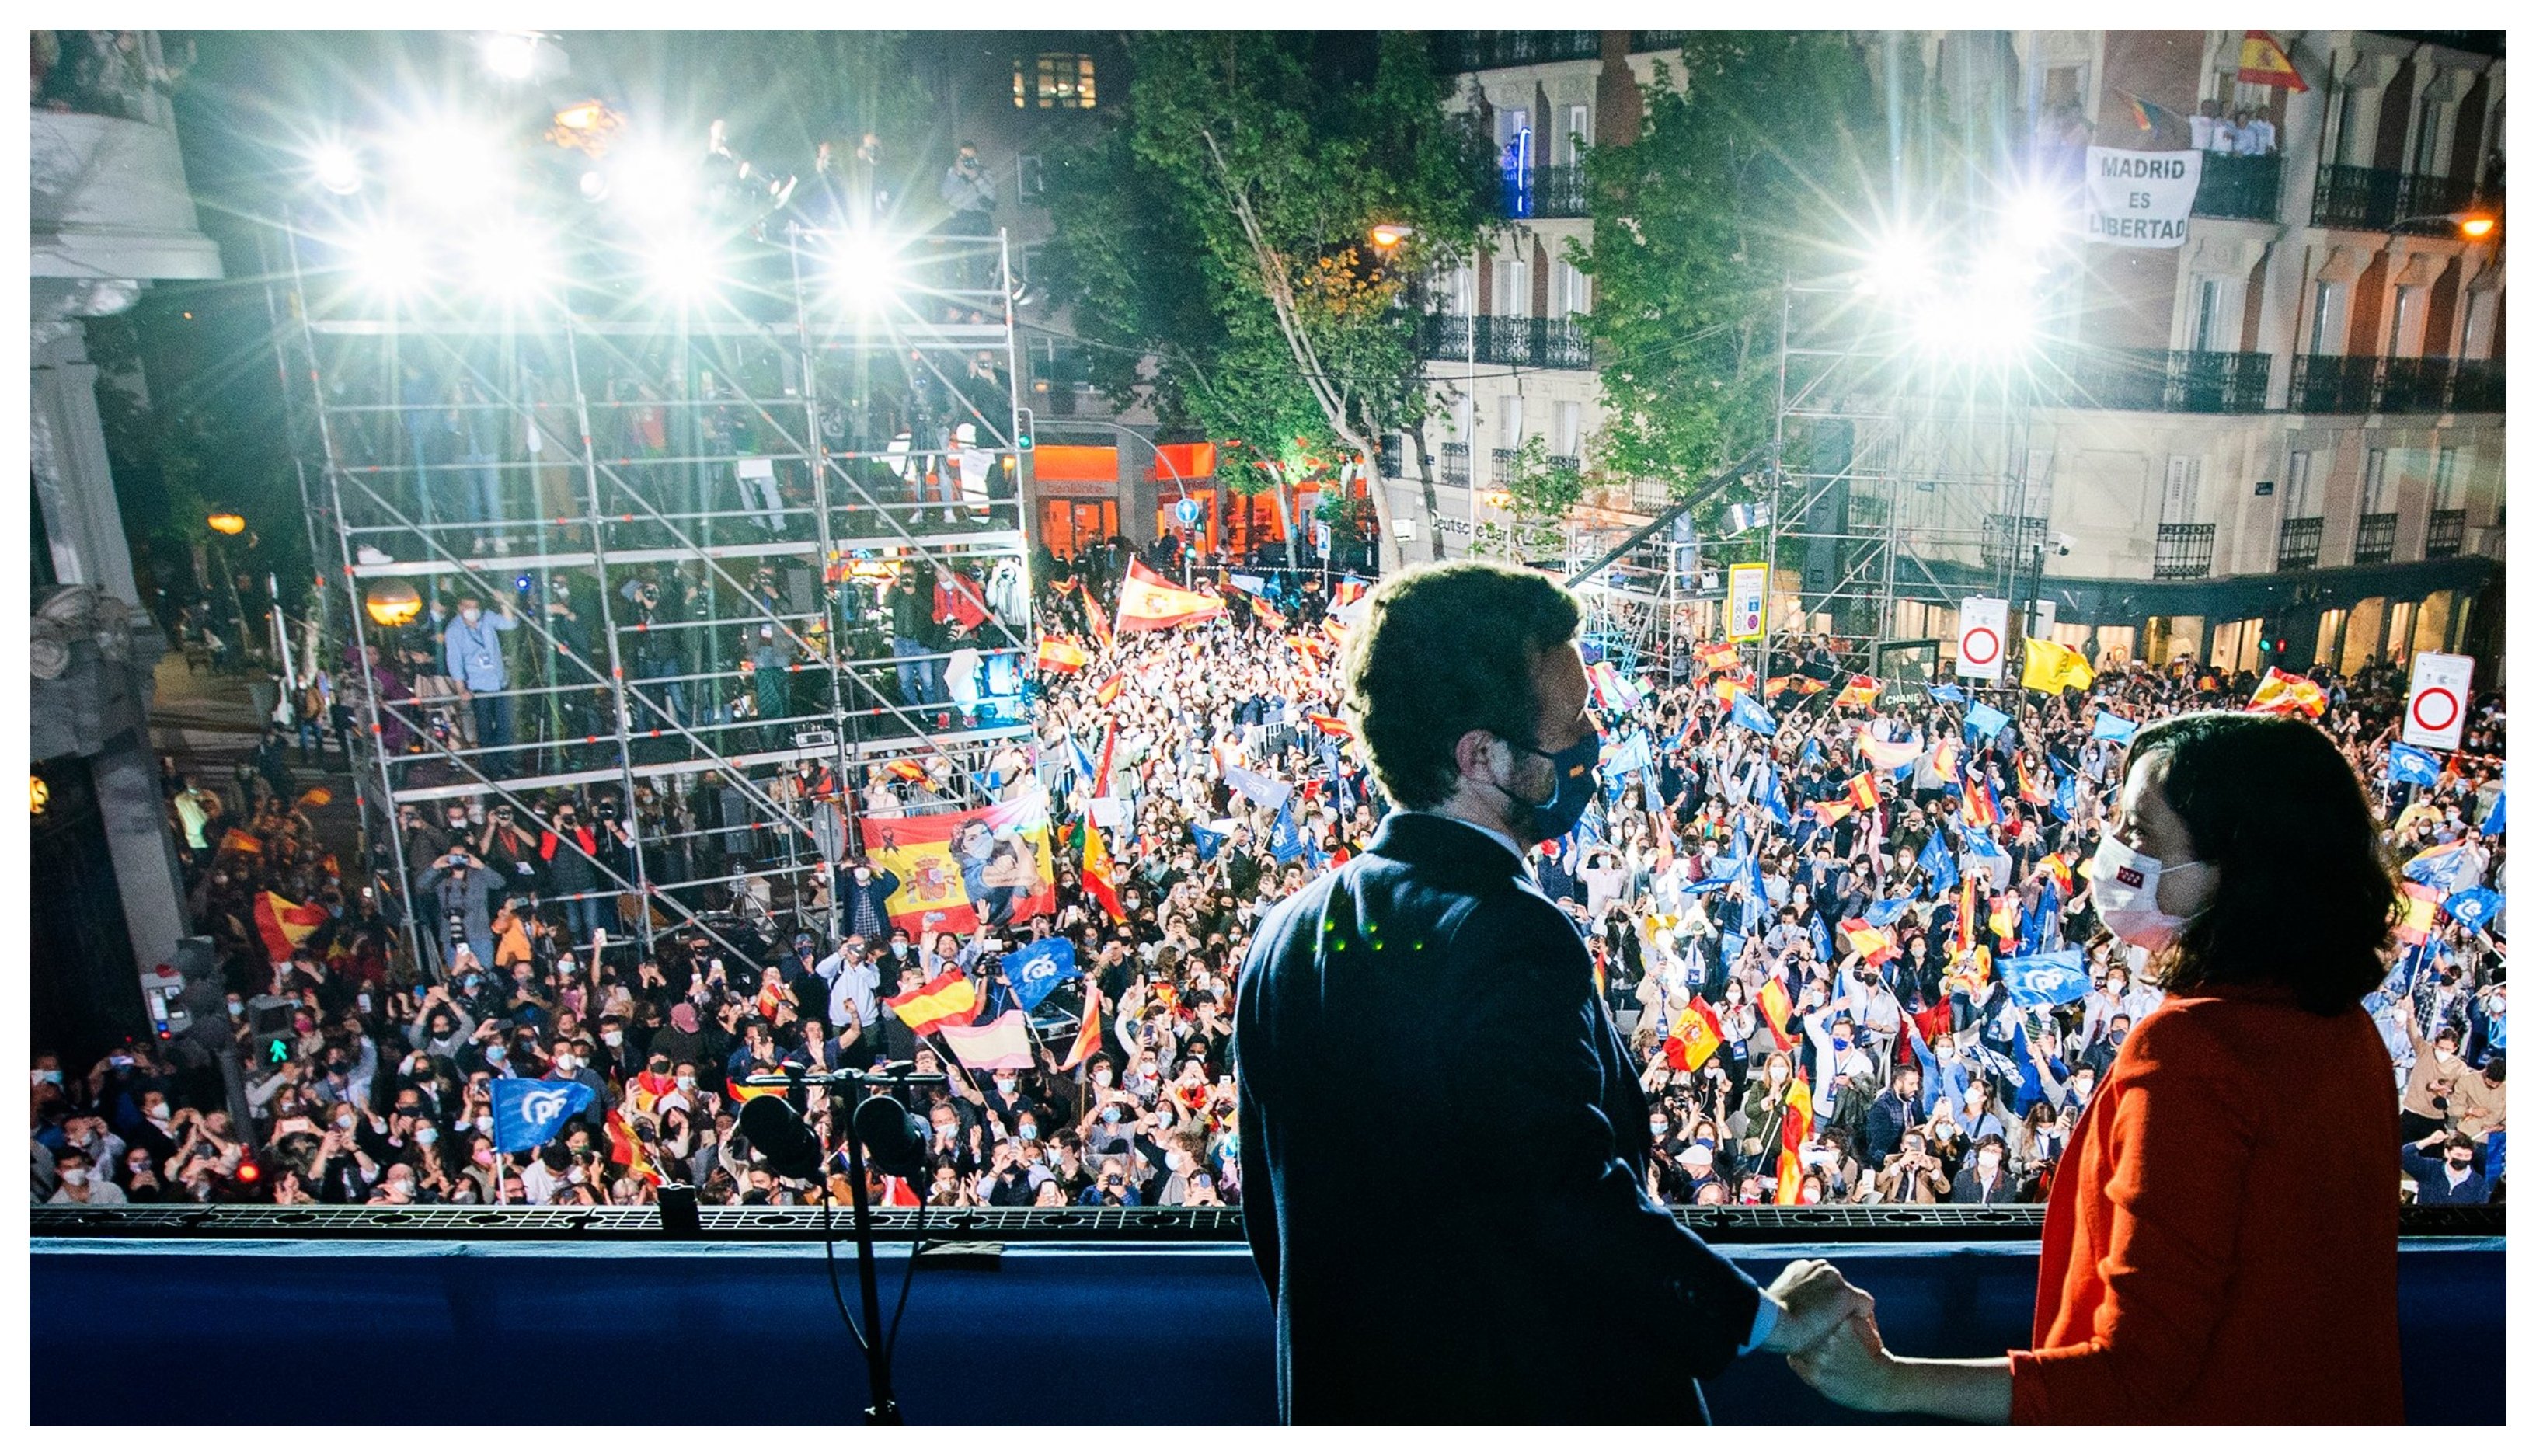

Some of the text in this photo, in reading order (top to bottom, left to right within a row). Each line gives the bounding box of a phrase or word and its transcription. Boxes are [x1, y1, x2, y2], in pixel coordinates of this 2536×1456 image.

[2101, 156, 2185, 179] MADRID
[2129, 191, 2151, 208] ES
[2089, 214, 2185, 239] LIBERTAD
[1430, 509, 1485, 538] Deutsce
[1886, 693, 1919, 705] CHANE
